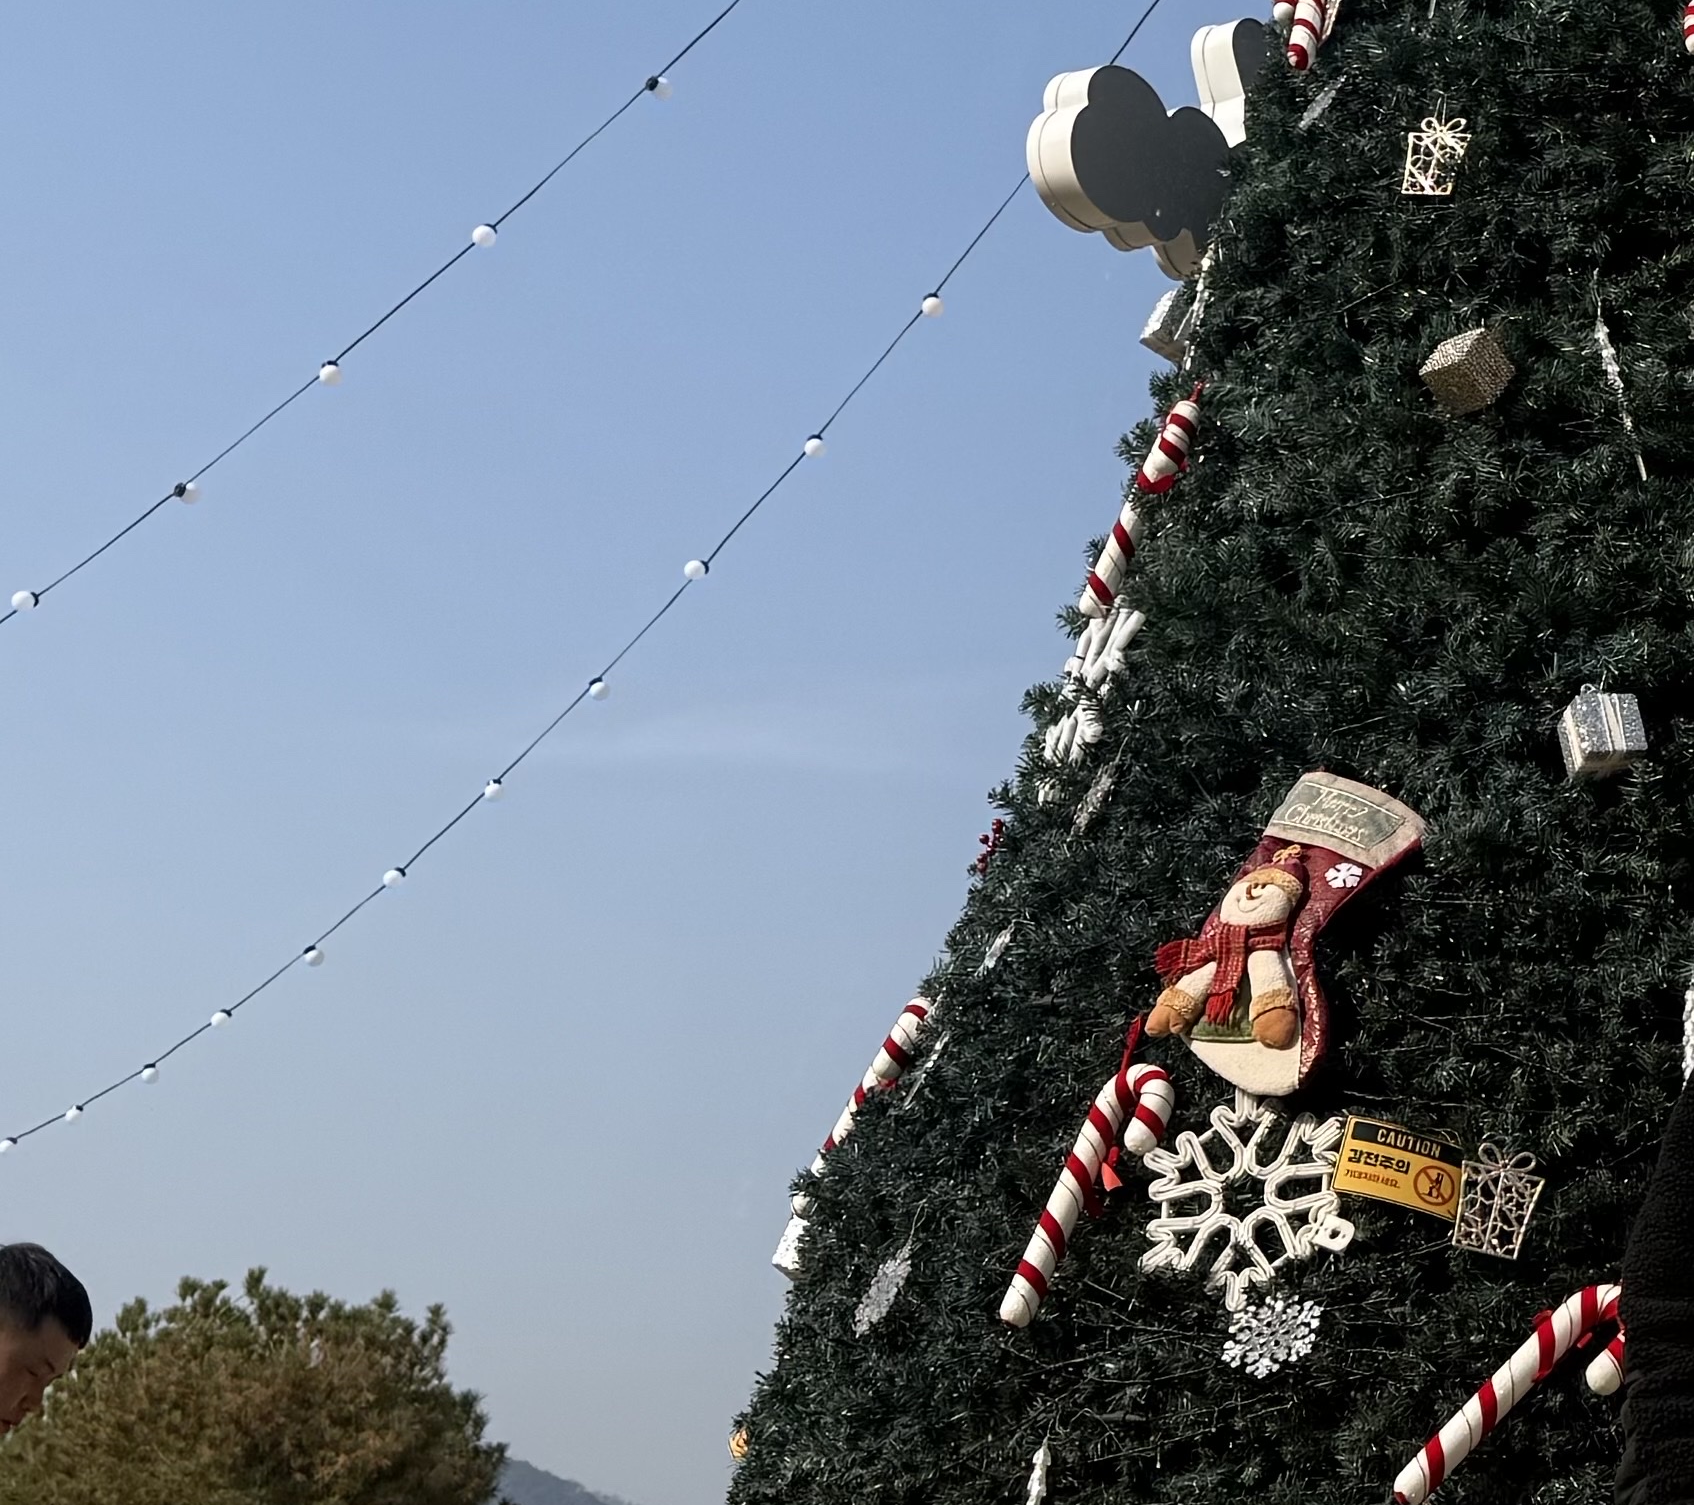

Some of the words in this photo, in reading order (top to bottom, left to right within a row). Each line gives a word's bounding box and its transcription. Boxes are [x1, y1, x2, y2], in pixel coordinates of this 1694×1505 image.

[1312, 788, 1369, 818] Merry
[1285, 803, 1365, 842] Christmas
[1376, 1128, 1441, 1159] CAUTION
[1347, 1149, 1411, 1175] 감전주의
